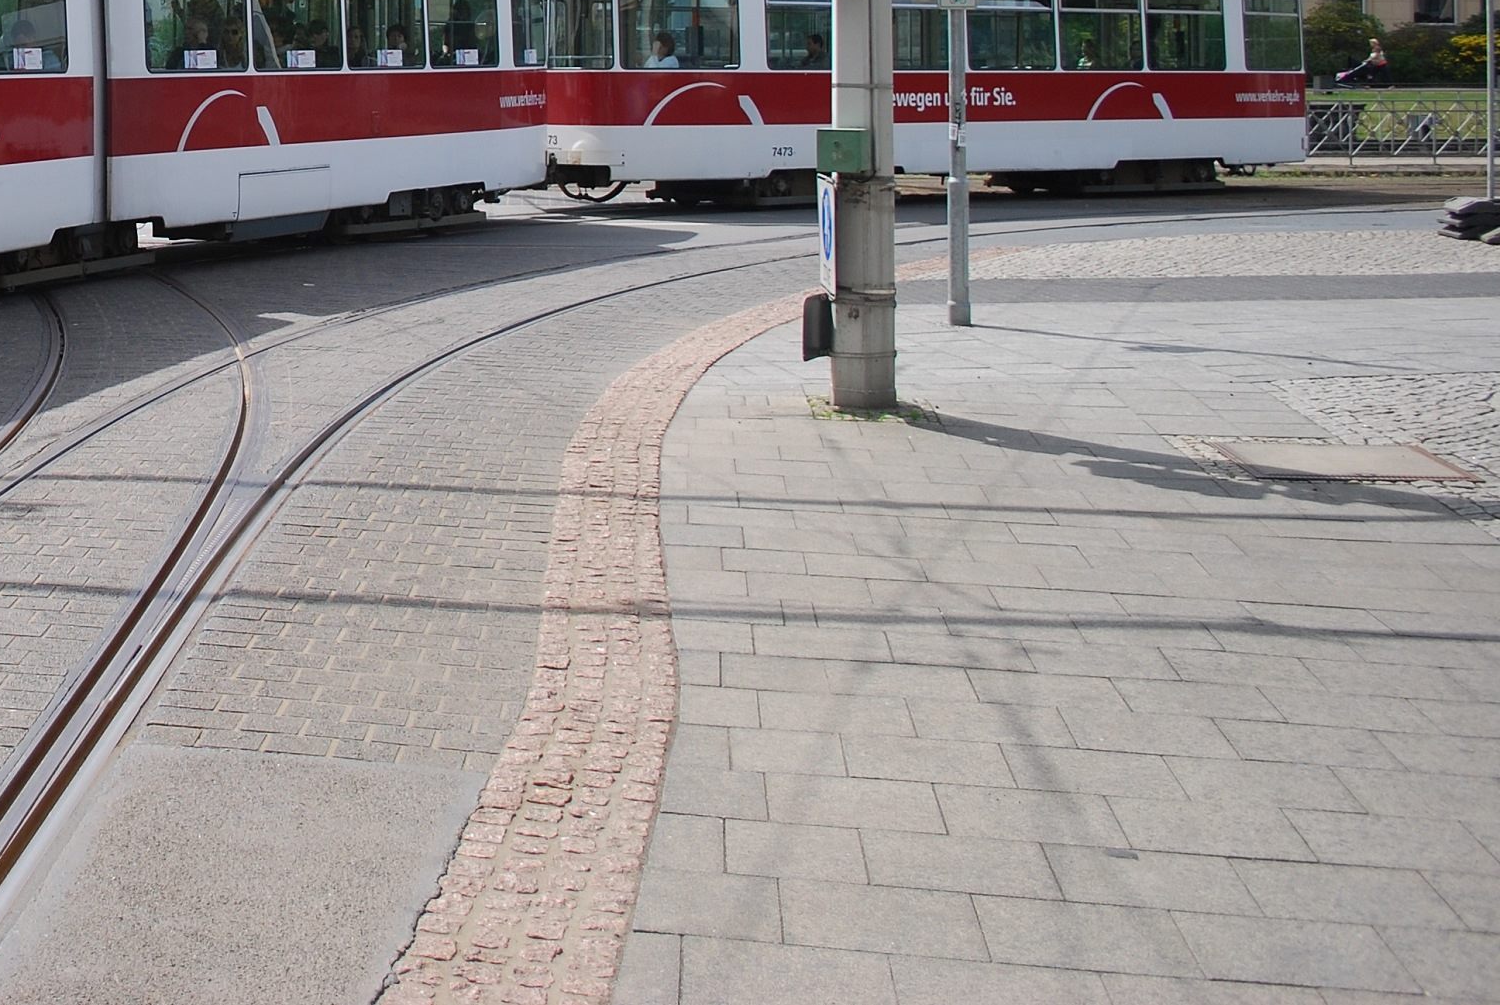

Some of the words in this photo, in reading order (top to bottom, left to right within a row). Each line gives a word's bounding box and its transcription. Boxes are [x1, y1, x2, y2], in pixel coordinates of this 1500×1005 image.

[892, 91, 941, 112] ewegen
[970, 87, 991, 106] für
[993, 87, 1017, 106] Sie.
[772, 147, 794, 157] 7473
